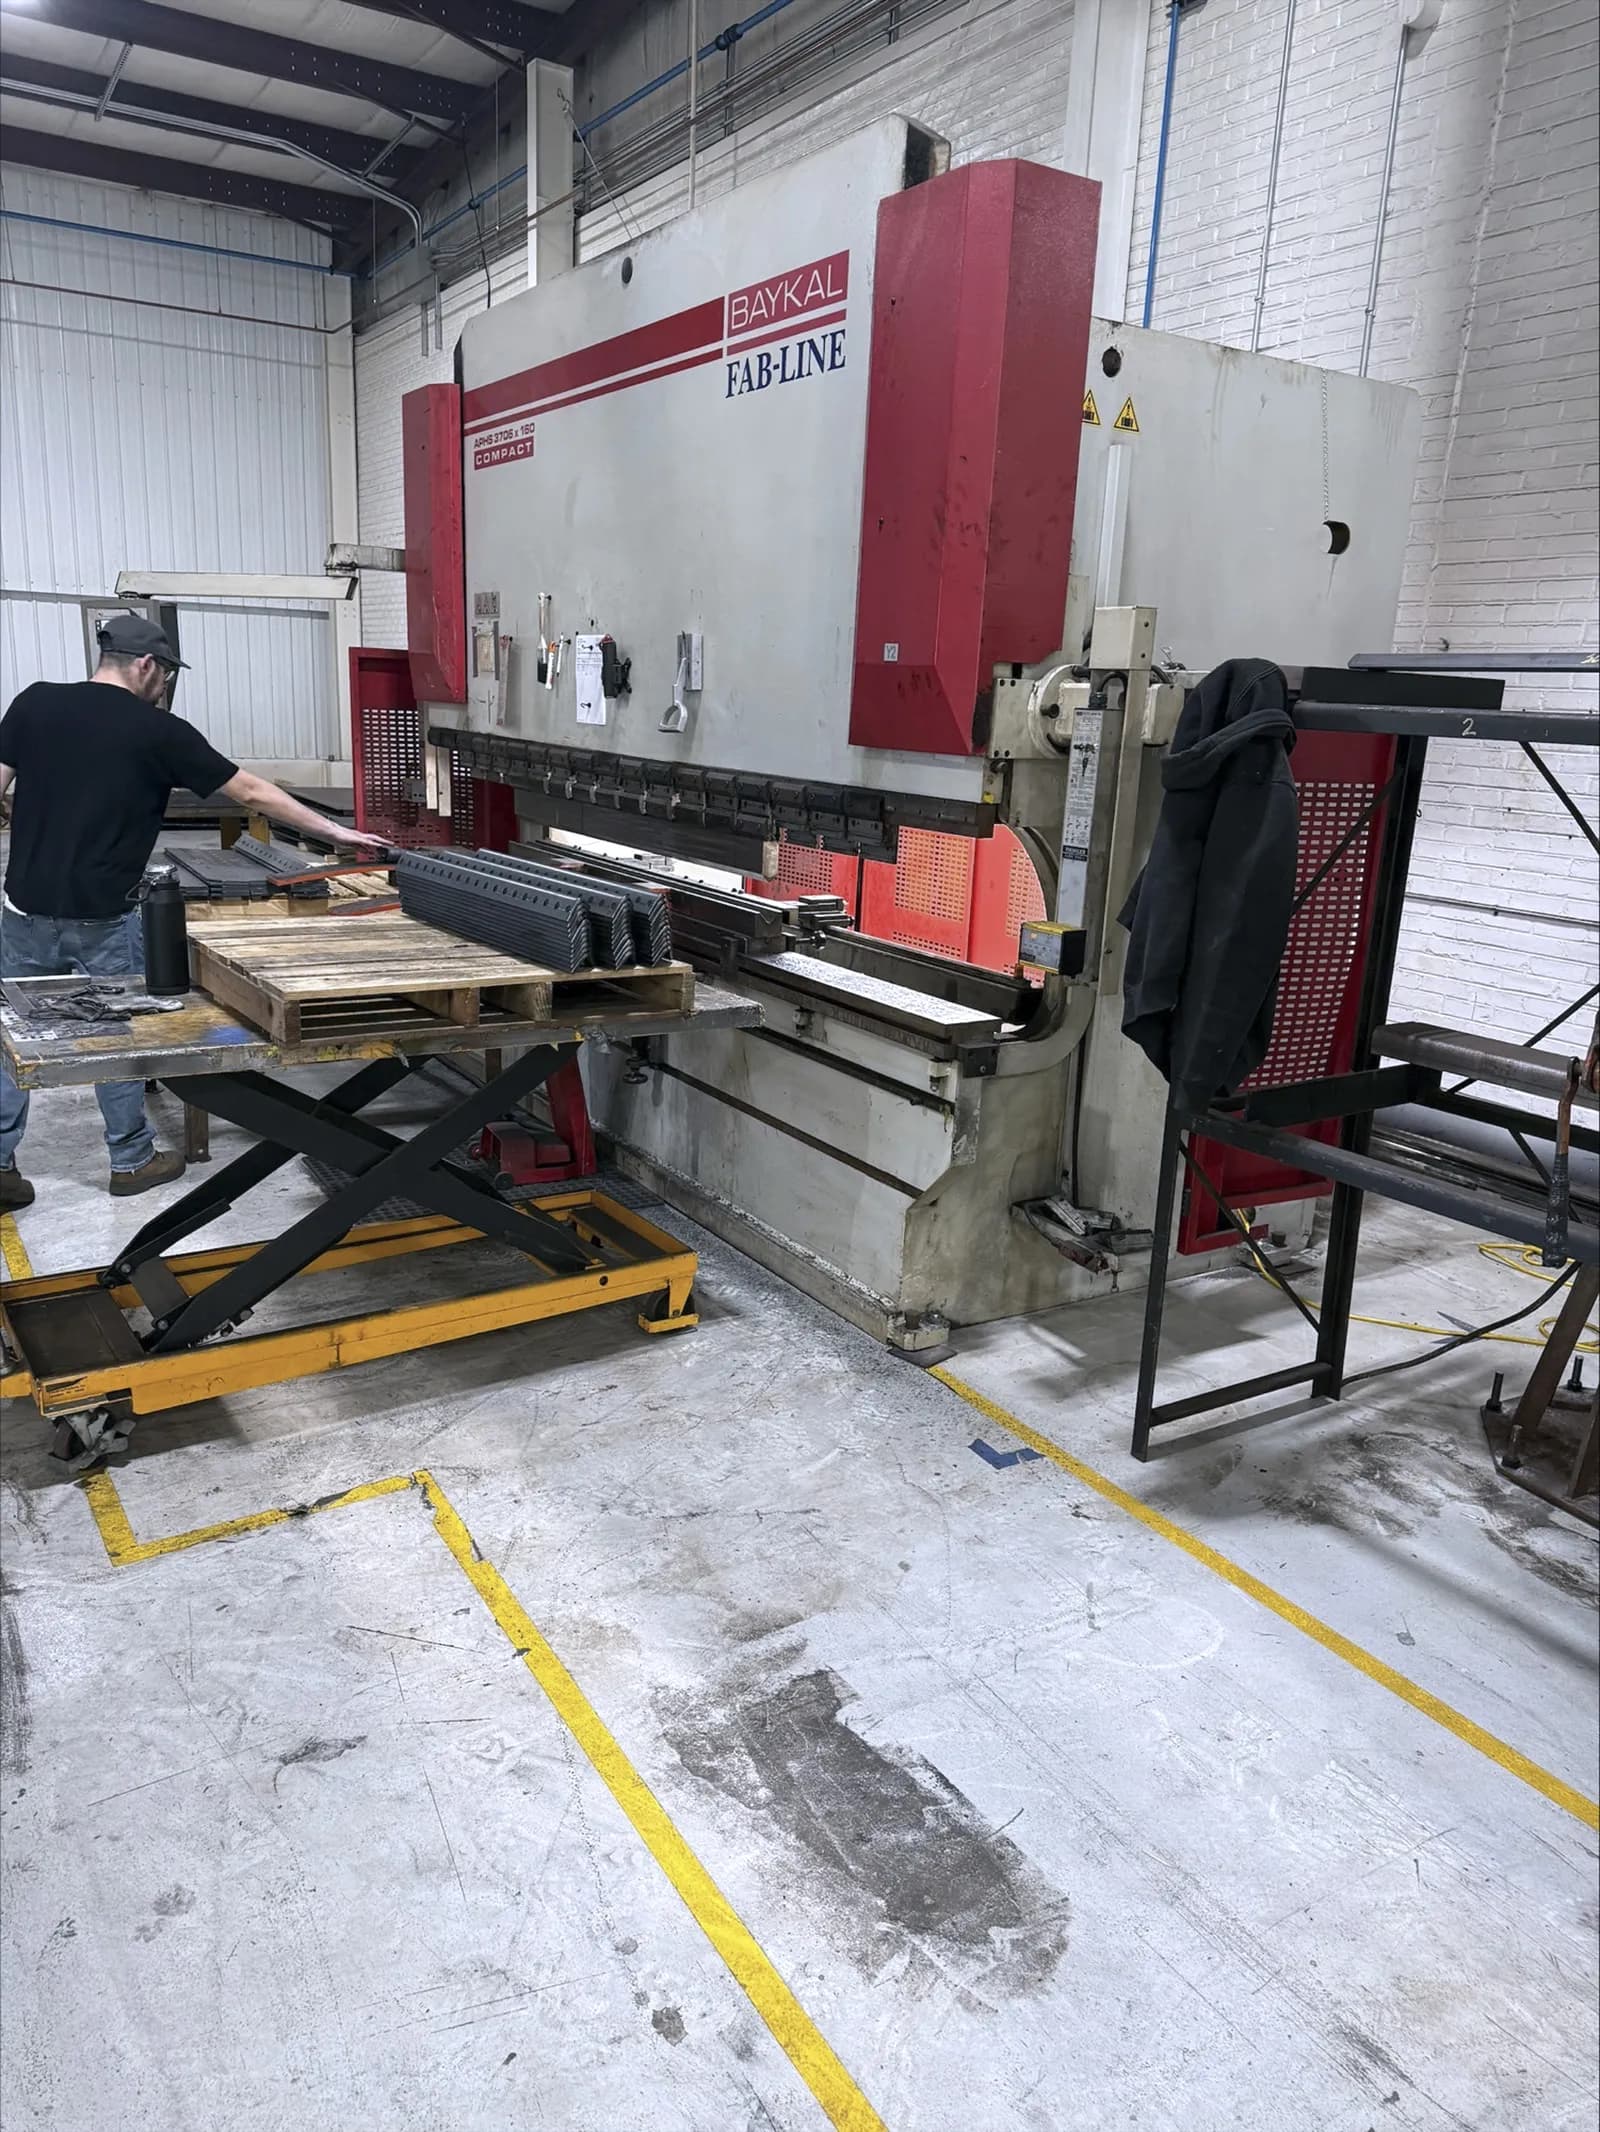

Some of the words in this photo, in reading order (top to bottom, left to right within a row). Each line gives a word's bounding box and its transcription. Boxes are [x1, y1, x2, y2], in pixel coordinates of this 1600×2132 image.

[731, 264, 843, 330] BAYKAL
[725, 329, 846, 398] FAB-LINE
[520, 423, 535, 435] 160
[475, 441, 532, 465] COMPACT
[1462, 717, 1477, 737] 2
